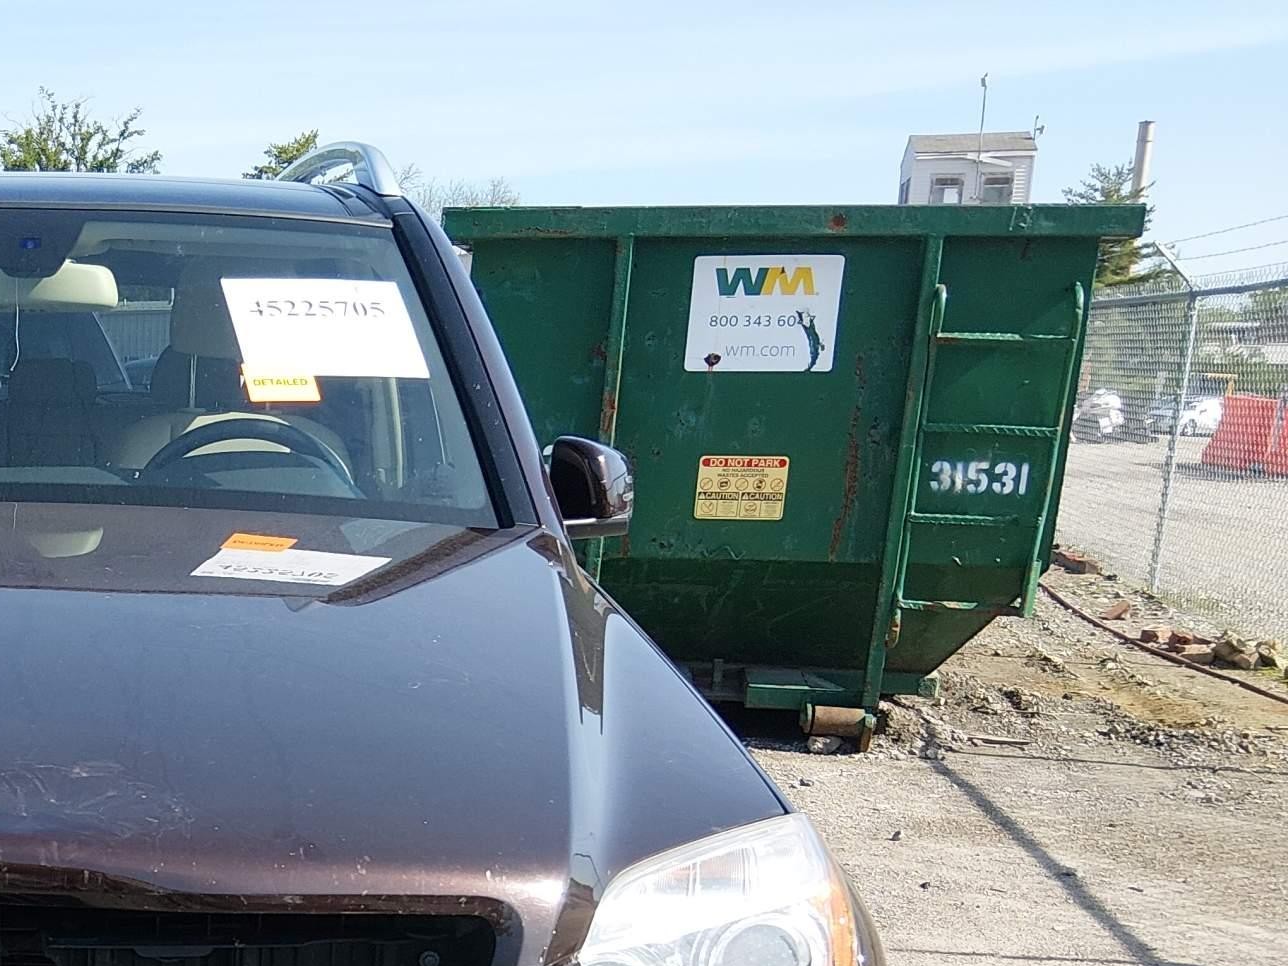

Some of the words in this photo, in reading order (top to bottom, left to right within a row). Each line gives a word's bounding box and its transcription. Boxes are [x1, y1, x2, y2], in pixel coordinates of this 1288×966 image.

[716, 267, 815, 296] WM
[249, 300, 385, 318] 45225705
[709, 315, 738, 327] 800
[743, 315, 771, 327] 343
[725, 344, 795, 357] wm.com
[253, 378, 308, 387] DETAILED
[710, 458, 726, 467] DO
[727, 458, 751, 467] NOT
[752, 459, 780, 467] PARK
[930, 461, 1029, 495] 31531
[705, 492, 739, 500] CAUTION
[749, 493, 782, 501] CAUTION
